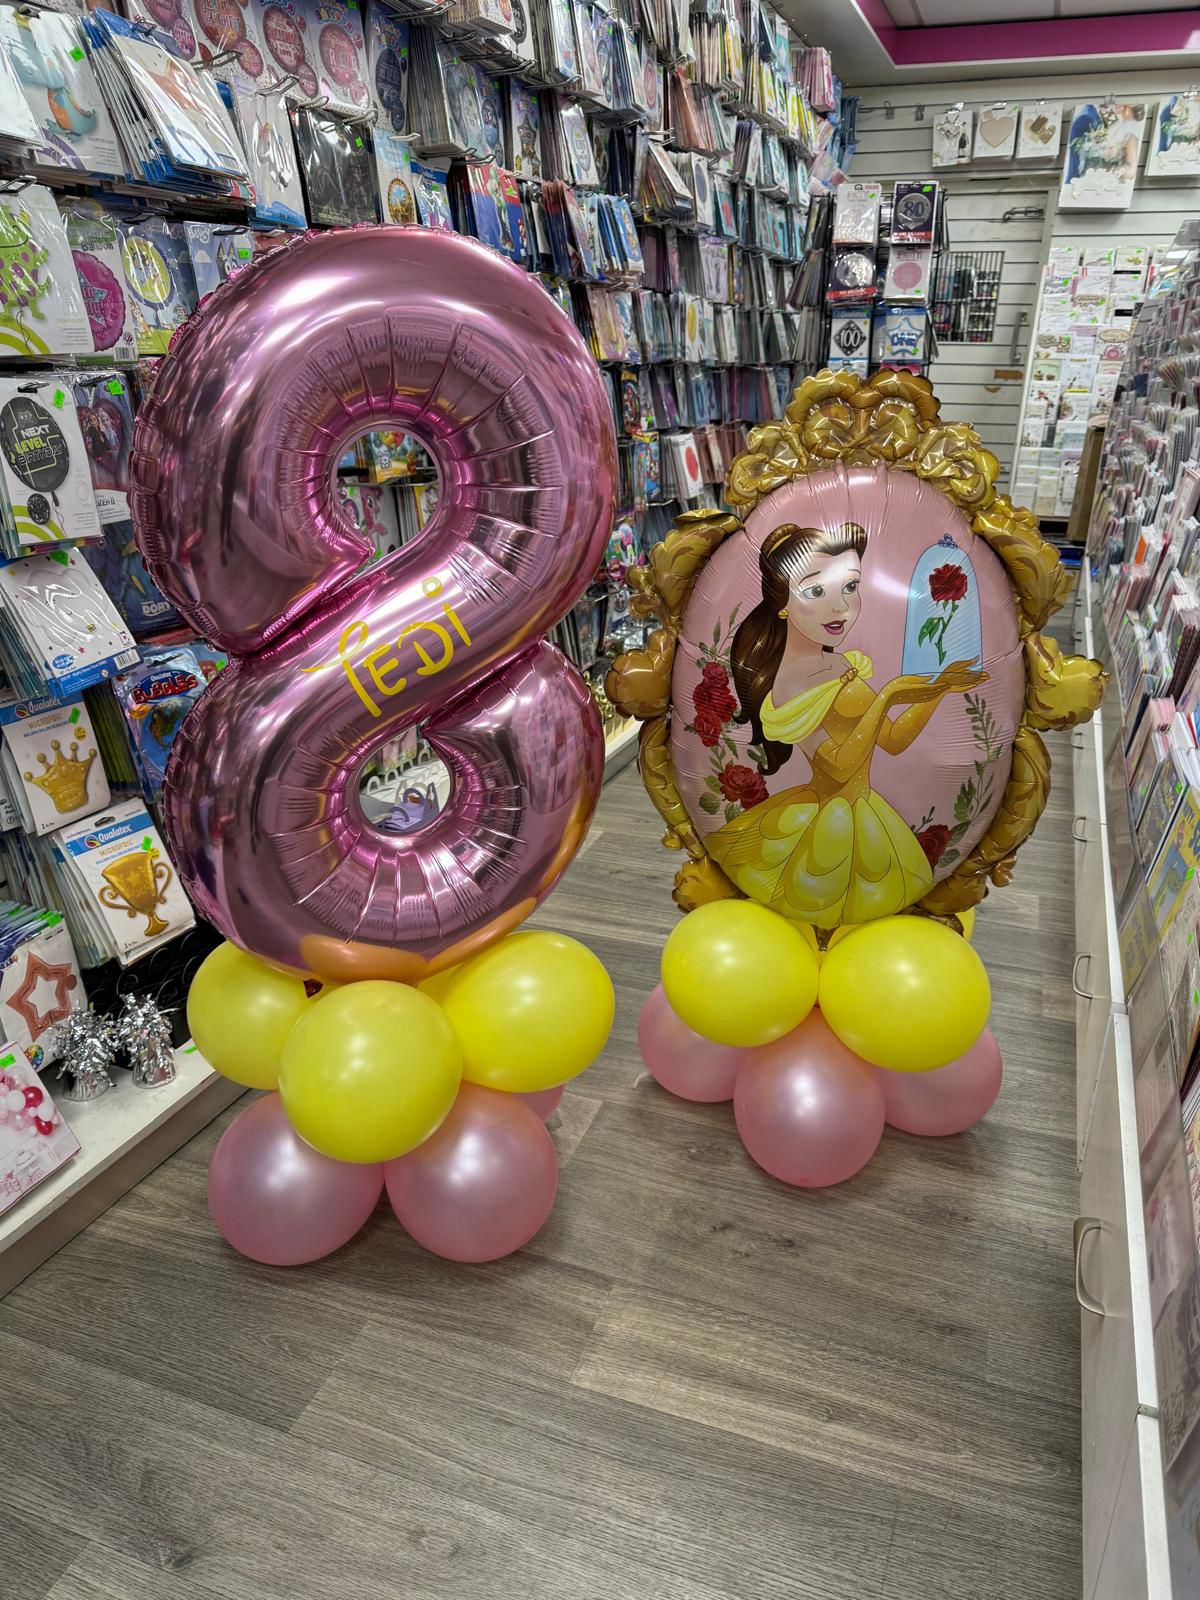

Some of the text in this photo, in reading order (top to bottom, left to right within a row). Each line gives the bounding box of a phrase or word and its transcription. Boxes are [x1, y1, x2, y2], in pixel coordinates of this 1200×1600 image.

[903, 200, 925, 218] 80
[840, 329, 861, 348] 100
[20, 424, 50, 438] NEXT
[14, 436, 48, 454] LEVEL
[17, 444, 64, 466] BIRTHDAY
[142, 602, 171, 615] DORY
[131, 674, 199, 705] BUBBLES
[28, 698, 63, 713] Qualatex
[97, 823, 133, 843] Qualatex
